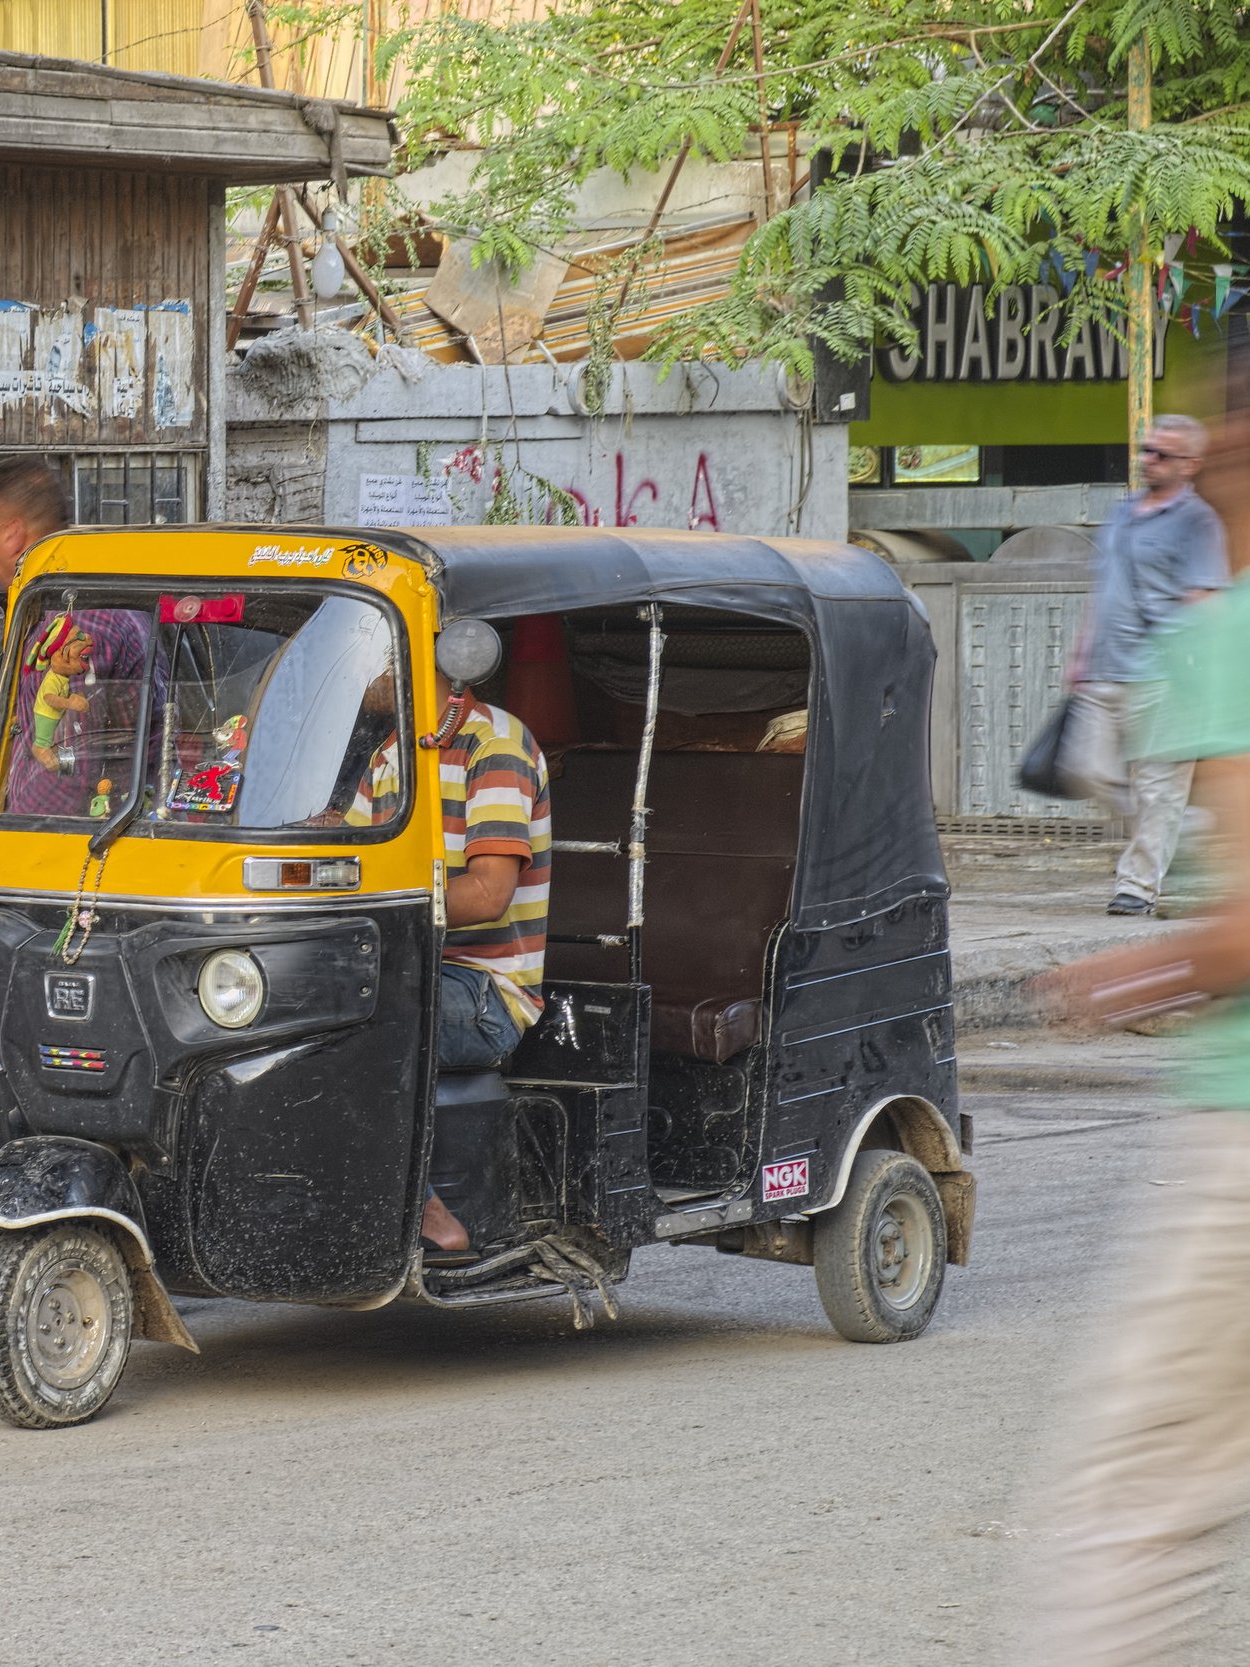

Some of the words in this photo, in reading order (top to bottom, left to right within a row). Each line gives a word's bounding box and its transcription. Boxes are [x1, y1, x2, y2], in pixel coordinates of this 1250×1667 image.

[53, 988, 86, 1011] RE
[765, 1162, 807, 1191] NGK
[764, 1190, 785, 1200] SPARK
[786, 1186, 806, 1198] PLUGS
